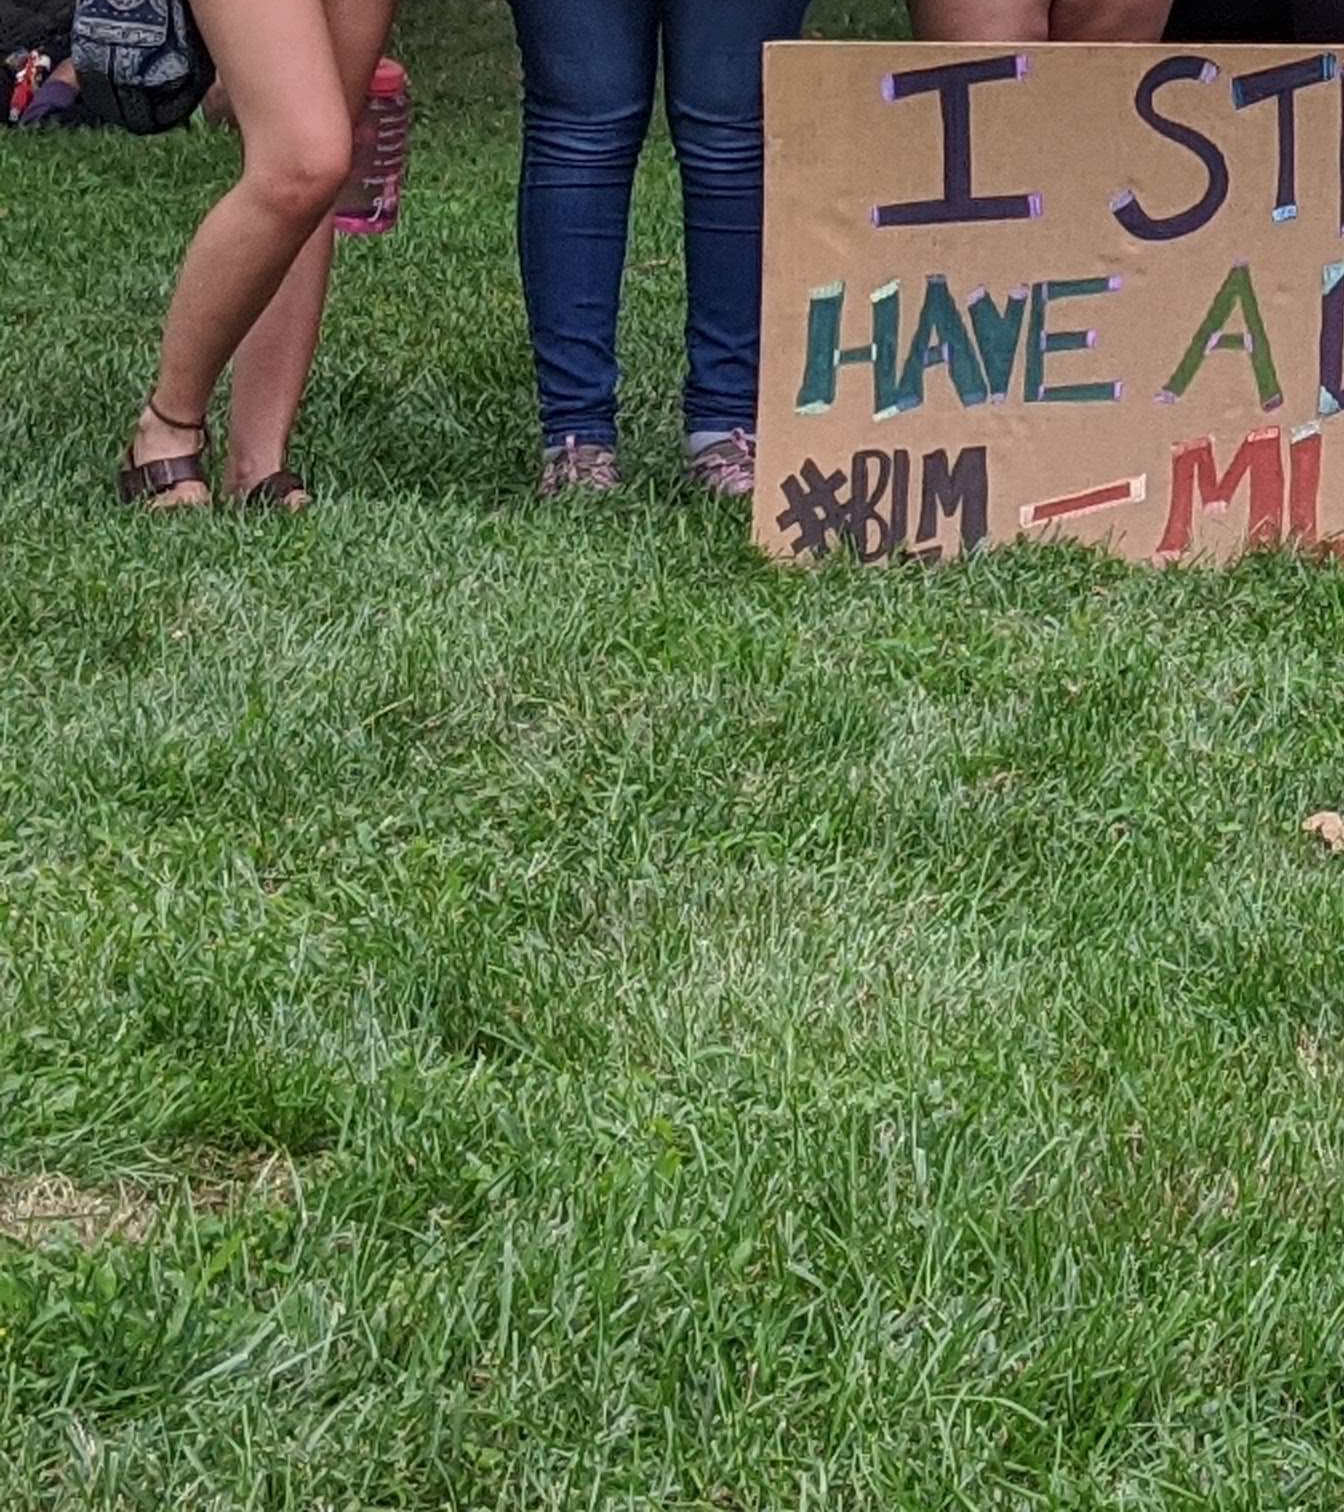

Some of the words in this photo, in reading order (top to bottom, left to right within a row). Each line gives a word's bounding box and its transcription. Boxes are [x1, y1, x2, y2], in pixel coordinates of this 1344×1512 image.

[869, 51, 1044, 228] I
[796, 272, 1125, 420] HAVE
[1153, 259, 1285, 412] A
[776, 445, 988, 564] #BLM
